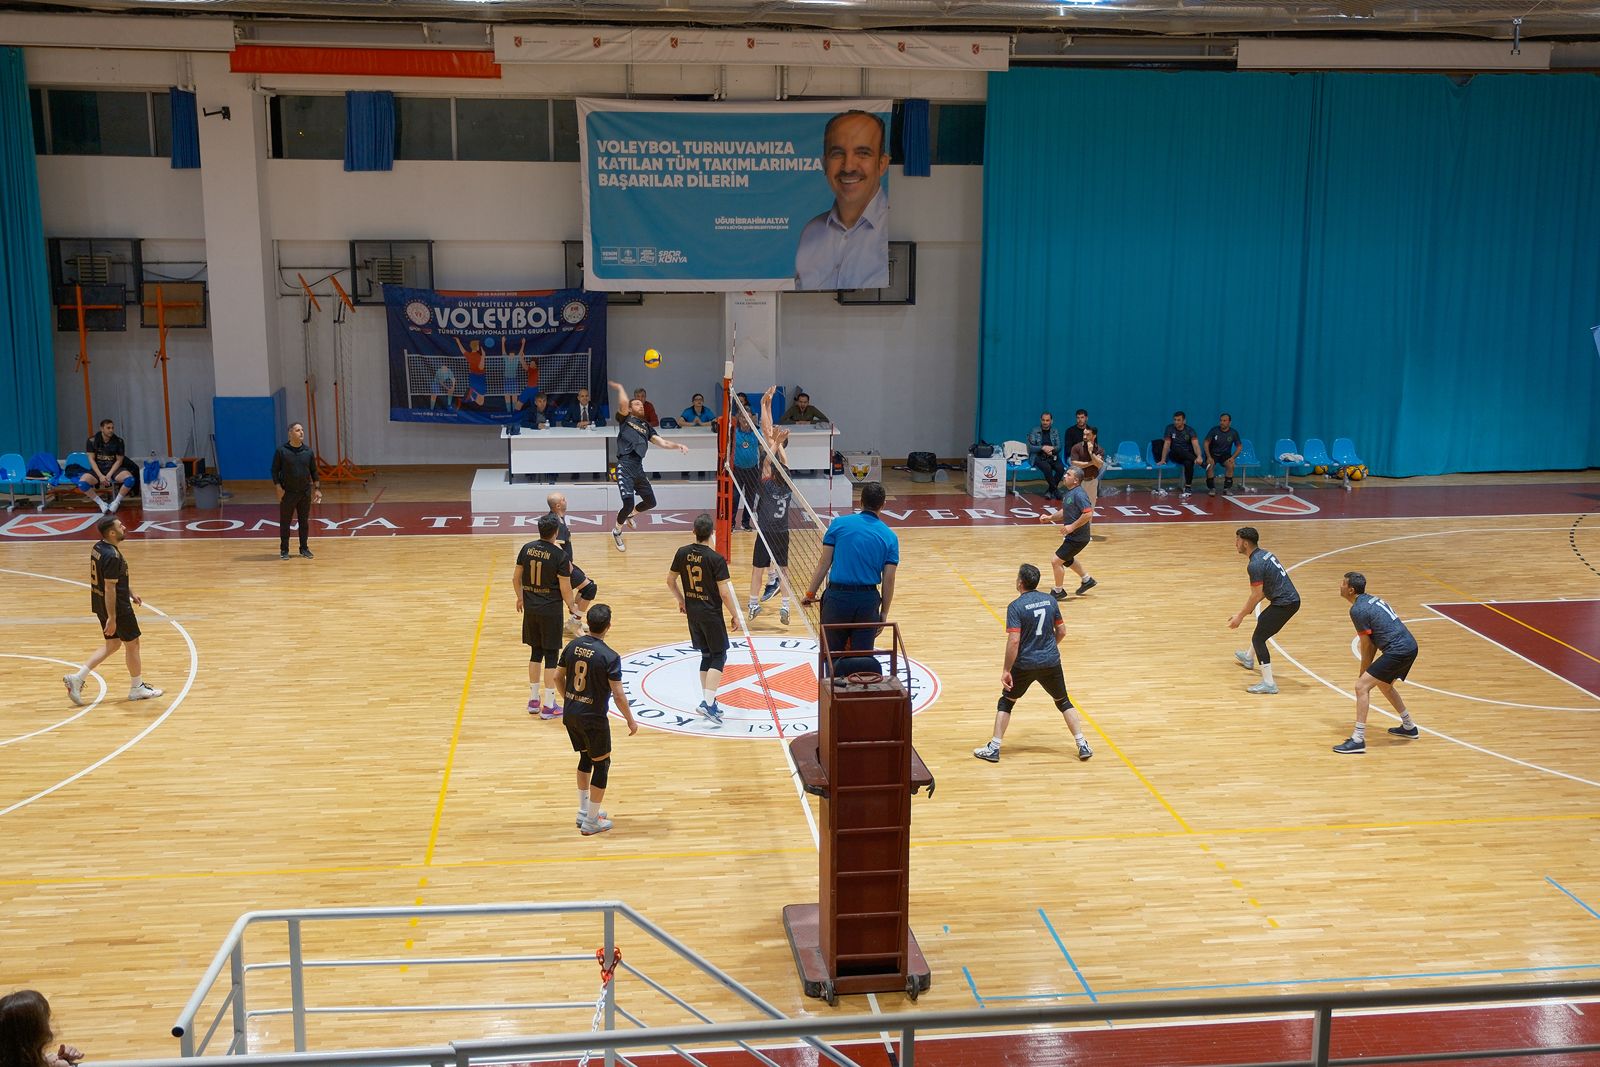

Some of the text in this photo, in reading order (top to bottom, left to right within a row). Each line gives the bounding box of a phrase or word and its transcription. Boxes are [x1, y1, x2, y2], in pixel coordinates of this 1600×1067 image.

[597, 140, 795, 156] VOLEYBOL TURNUVAMIZA
[598, 155, 823, 172] KATILAN TÜM TAKIMLARIMIZA
[598, 172, 749, 190] BAŞARILAR DİLERİM
[715, 216, 735, 225] UĞUR
[767, 217, 789, 225] ALTAY
[658, 256, 688, 264] KONYA
[458, 300, 513, 308] ÜNİVERSİTELER
[434, 306, 560, 329] VOLEYBOL
[464, 328, 507, 337] ŞAMPİYONASI
[527, 327, 557, 335] GRUPLARI
[774, 498, 787, 519] 3
[129, 517, 404, 533] KONYA
[420, 512, 696, 529] TEKNK
[526, 547, 551, 560] HÜSEYİN
[686, 552, 703, 563] CİHAT
[529, 559, 543, 587] 11
[1270, 556, 1286, 577] 5
[686, 564, 703, 593] 12
[1033, 608, 1046, 636] 7
[574, 646, 595, 659] EŞREF
[573, 660, 588, 692] 8
[747, 723, 809, 733] 1970
